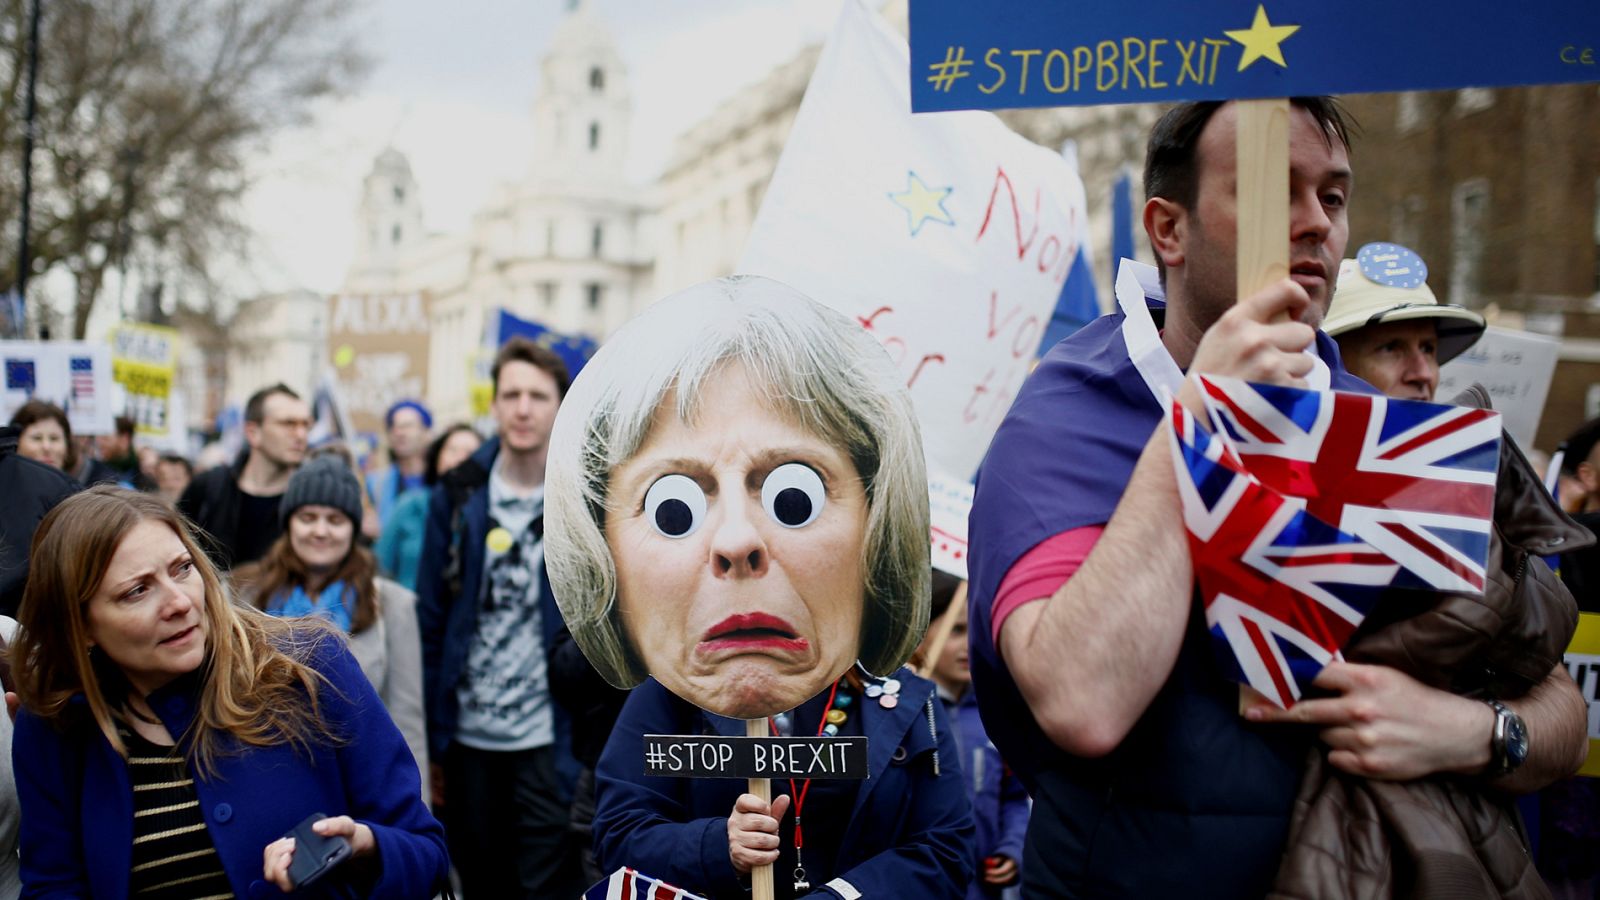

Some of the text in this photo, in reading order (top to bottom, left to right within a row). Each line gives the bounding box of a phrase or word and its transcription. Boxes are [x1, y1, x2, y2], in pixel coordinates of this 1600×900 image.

[926, 37, 1231, 95] #STOPBREXIT
[645, 742, 853, 774] #STOP BREXIT
